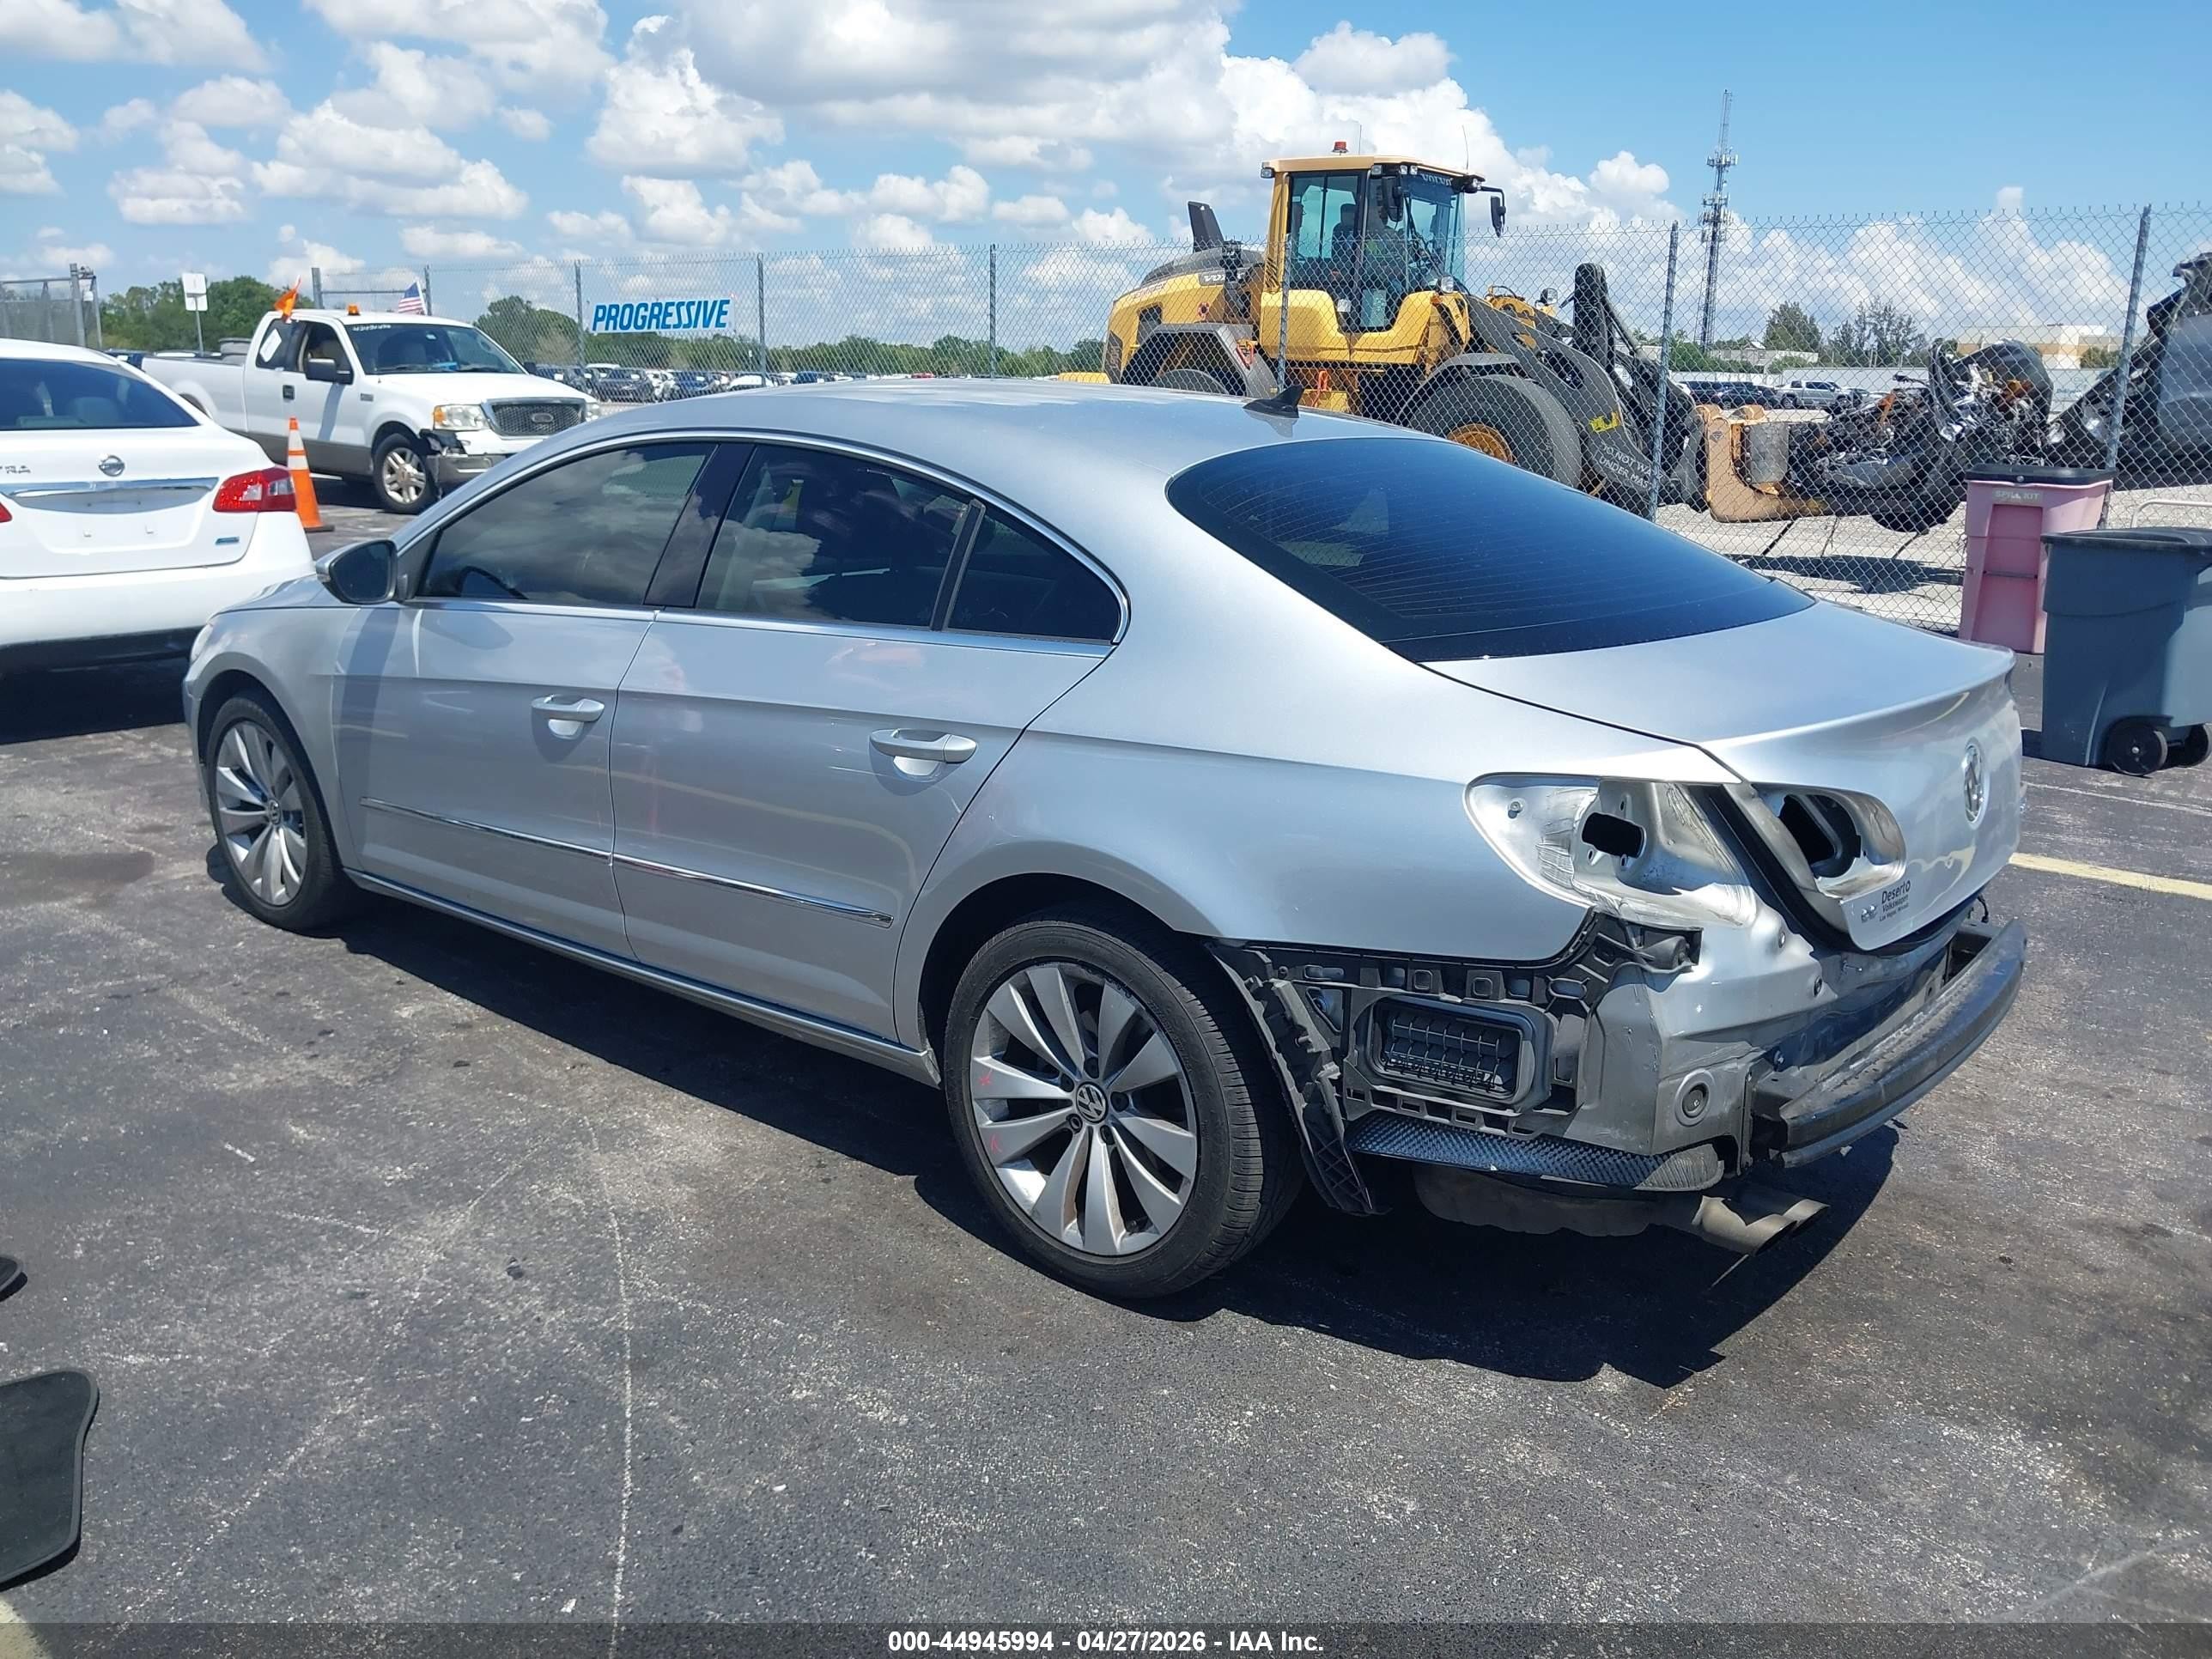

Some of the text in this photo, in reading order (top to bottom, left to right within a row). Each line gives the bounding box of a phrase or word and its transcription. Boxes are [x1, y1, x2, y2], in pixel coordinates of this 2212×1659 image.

[592, 300, 731, 331] PROGRESSIVE
[1599, 456, 1629, 477] UNDER
[1881, 879, 1911, 905] Deserto
